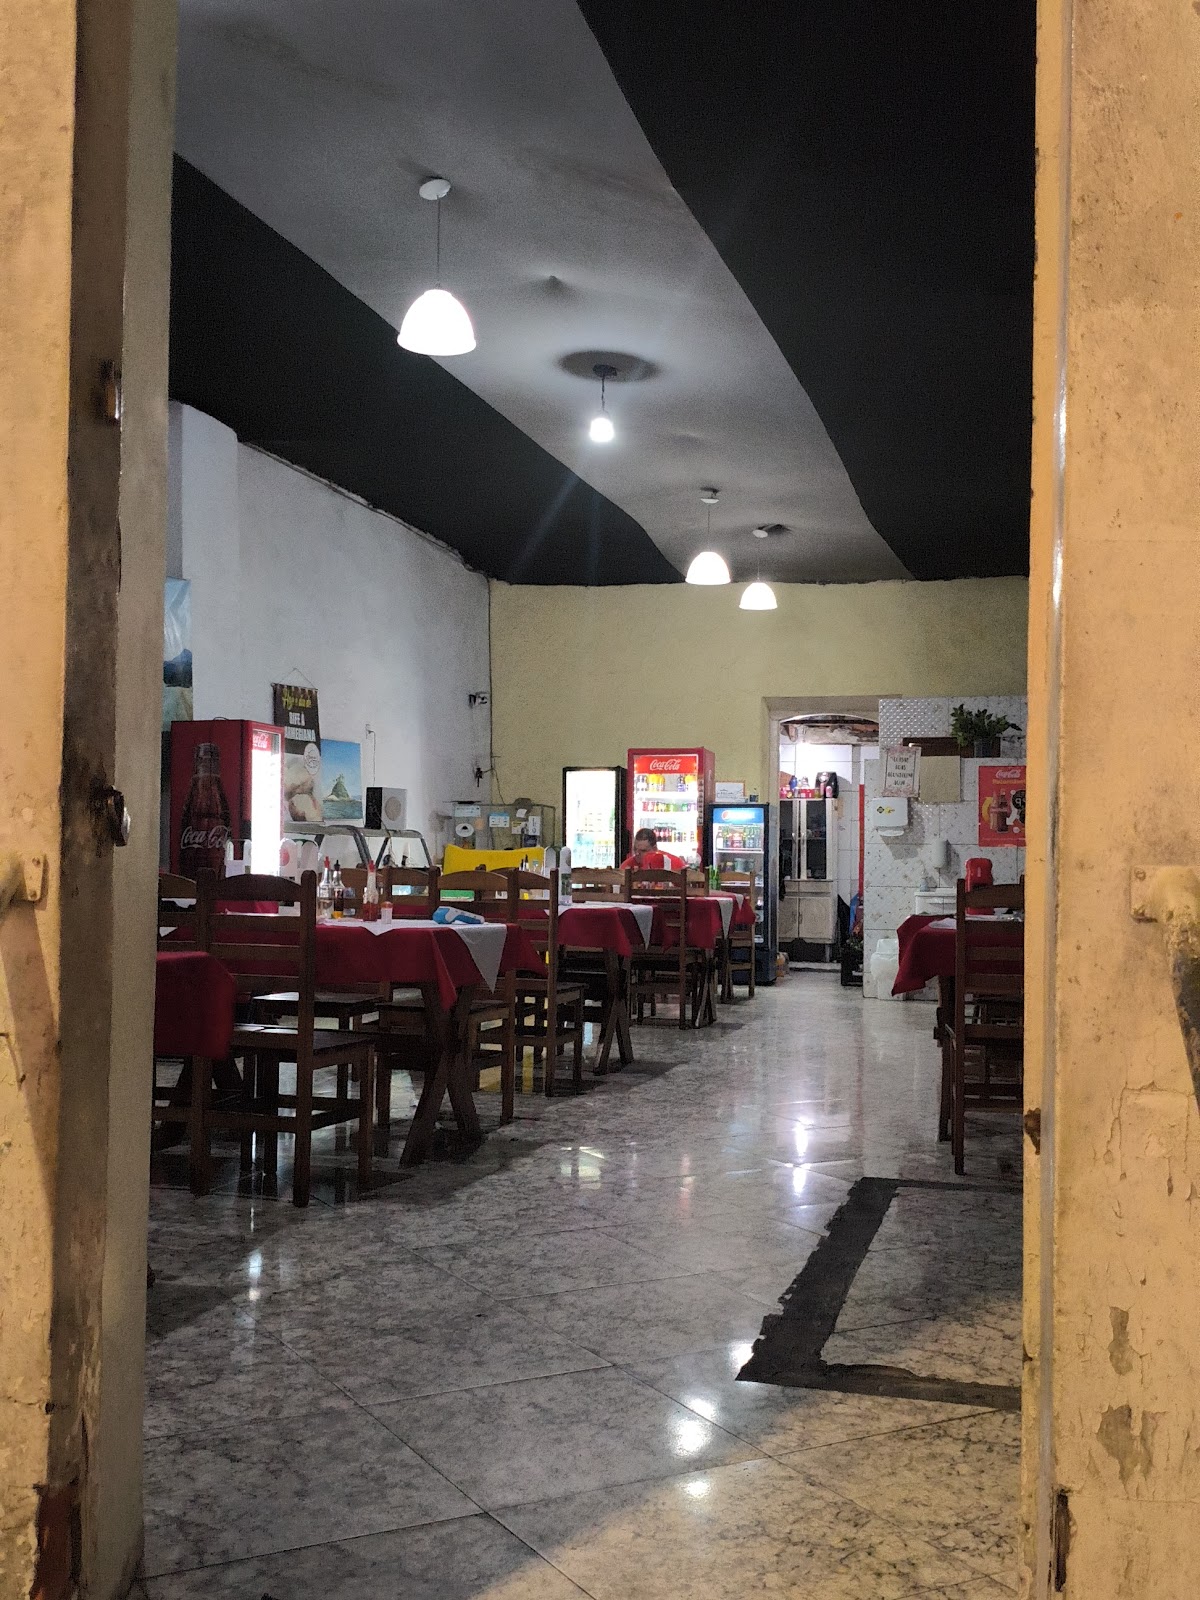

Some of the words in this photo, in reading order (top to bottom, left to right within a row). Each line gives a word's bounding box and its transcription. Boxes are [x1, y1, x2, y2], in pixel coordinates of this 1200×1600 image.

[289, 711, 301, 726] BIFE
[284, 725, 316, 742] ARMEGIANA
[649, 758, 682, 771] Coca-Cola
